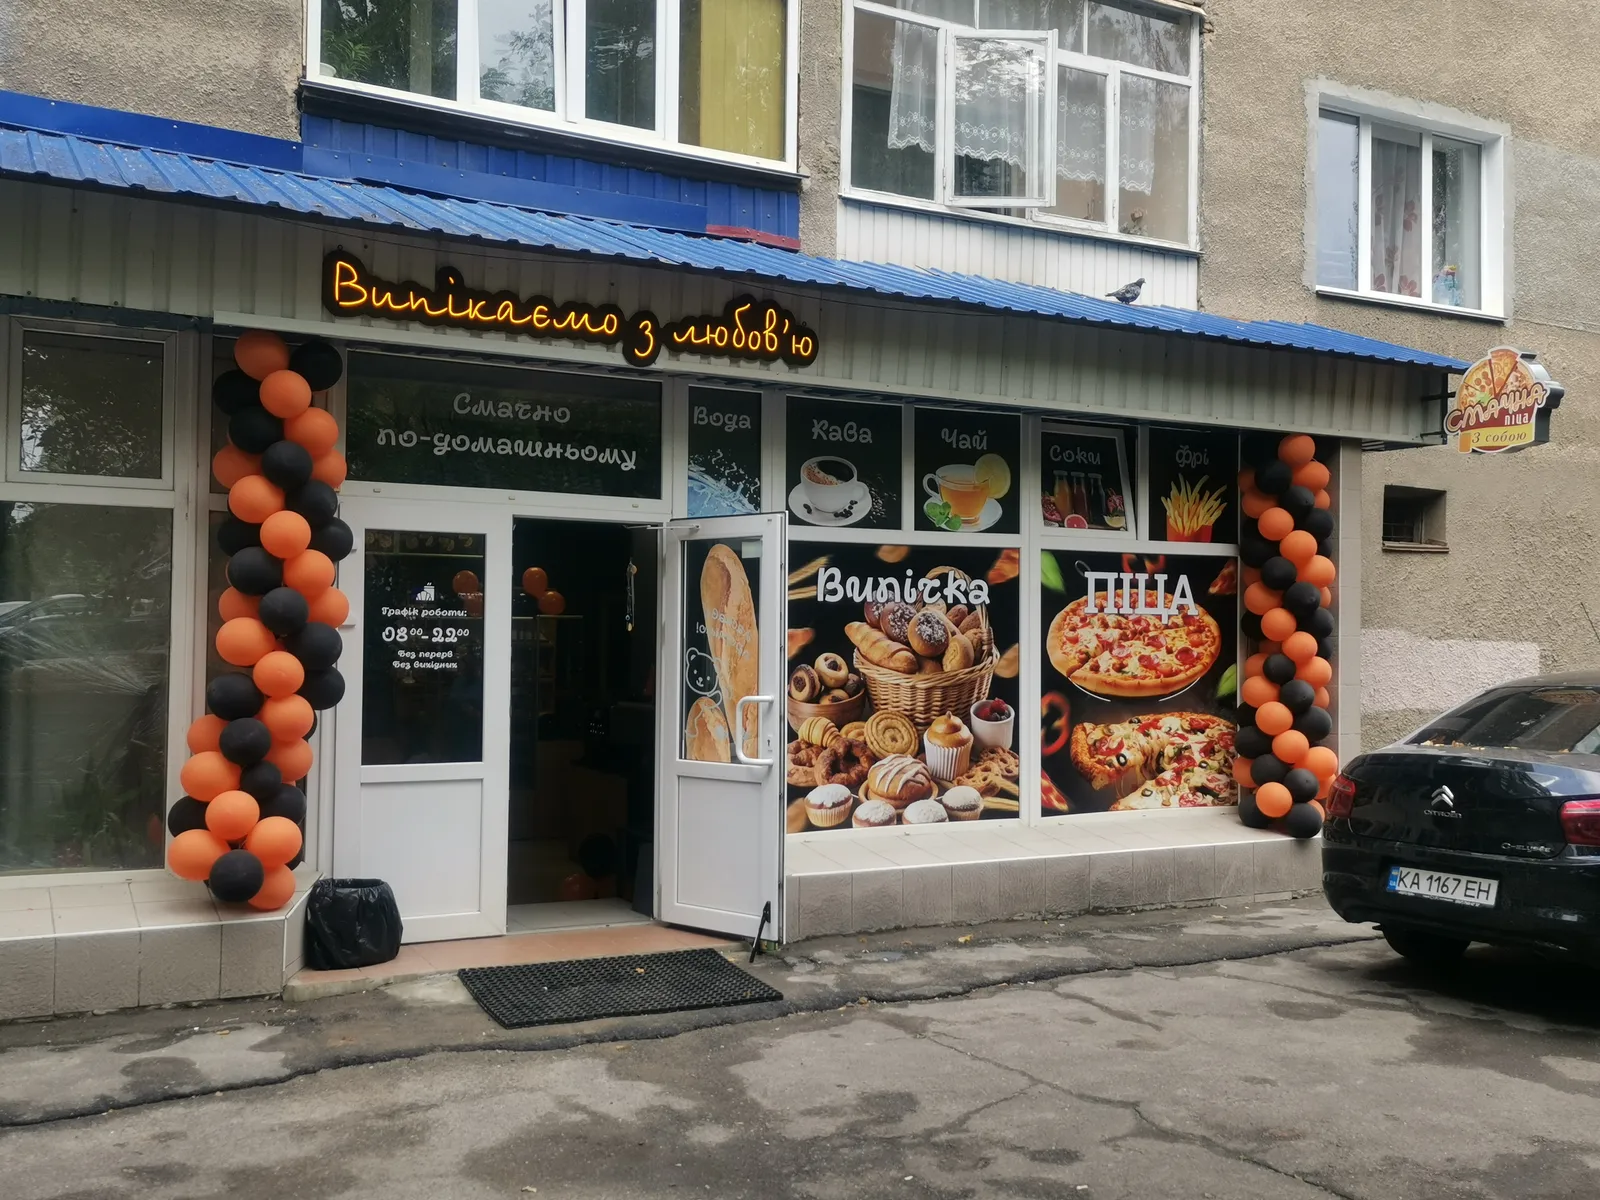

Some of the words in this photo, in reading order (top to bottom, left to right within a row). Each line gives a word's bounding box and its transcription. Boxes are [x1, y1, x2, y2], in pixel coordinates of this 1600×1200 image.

[333, 260, 618, 335] Випікаємо
[673, 302, 813, 357] любов'ю
[453, 392, 572, 425] Смачно
[693, 406, 752, 432] Вода
[812, 418, 873, 444] Кава
[940, 427, 988, 451] Чай
[1485, 431, 1527, 443] собою
[376, 427, 637, 472] по-домашньому
[1049, 444, 1101, 466] Соки
[816, 566, 991, 606] Випічка
[1084, 570, 1199, 625] ПІЦА
[381, 607, 419, 617] Графік
[421, 607, 467, 618] роботи:
[392, 661, 411, 670] Без
[413, 660, 458, 670] вихідних
[398, 650, 416, 660] Без
[418, 650, 453, 660] перерв
